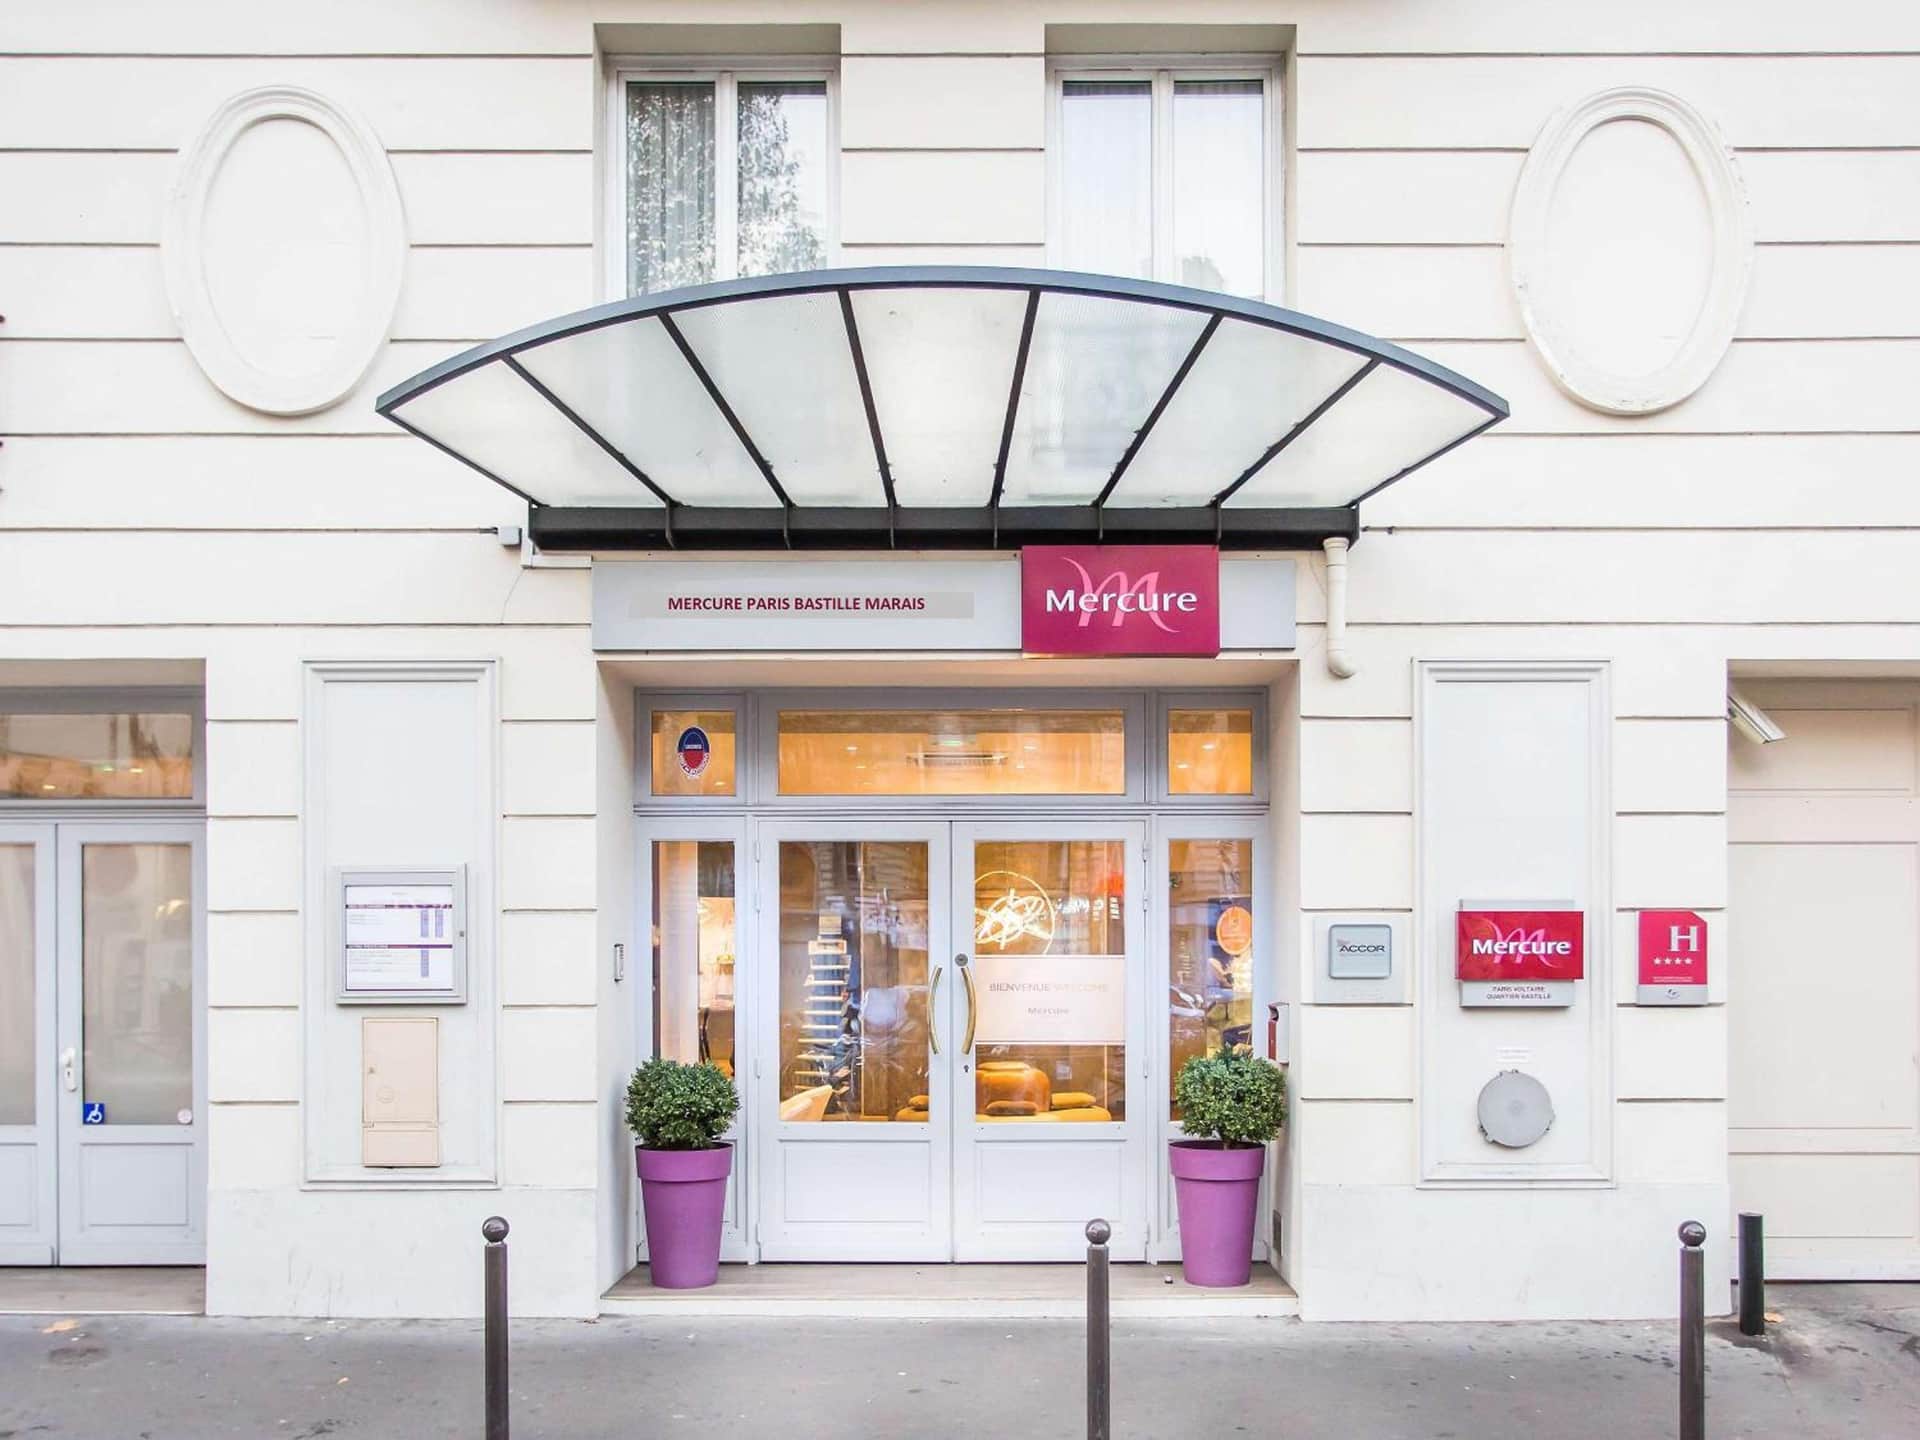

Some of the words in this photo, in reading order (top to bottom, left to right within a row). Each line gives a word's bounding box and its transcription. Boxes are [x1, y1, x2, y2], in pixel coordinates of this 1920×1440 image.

[668, 597, 742, 610] MERCURE
[747, 597, 790, 610] PARIS
[794, 597, 860, 610] BASTILLE
[865, 597, 925, 610] MARAIS
[1045, 588, 1198, 613] Mercure
[1668, 925, 1700, 952] H
[1339, 944, 1385, 953] ACCOR
[1472, 938, 1571, 955] Mercure
[989, 982, 1050, 993] BIENVENUE
[1027, 1006, 1070, 1017] Mercure
